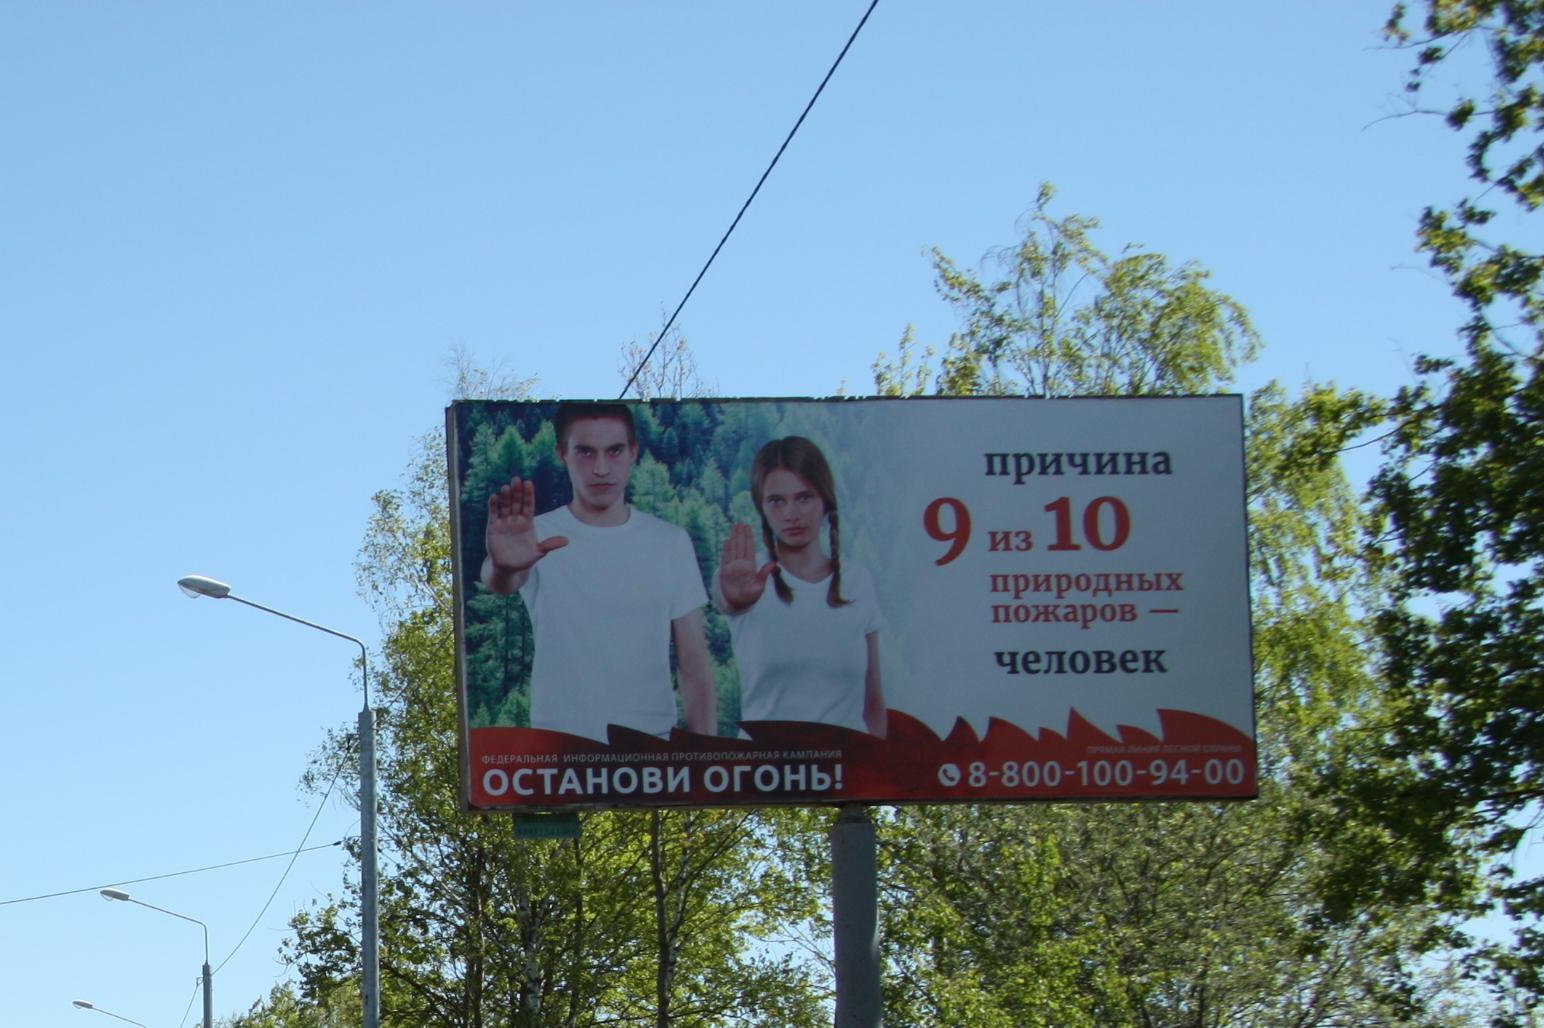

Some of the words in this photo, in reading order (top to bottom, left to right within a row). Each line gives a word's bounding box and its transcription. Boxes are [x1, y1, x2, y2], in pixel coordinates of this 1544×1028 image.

[983, 450, 1173, 485] причина
[923, 496, 972, 567] 9
[987, 530, 1034, 552] из
[1043, 495, 1131, 552] 10
[989, 572, 1185, 600] природных
[991, 602, 1139, 630] пожаров
[993, 648, 1169, 675] человек
[481, 753, 558, 765] ФЕДЕРАЛЬНАЯ
[563, 751, 669, 763] ИНФОРМАЦИОННАЯ
[671, 750, 780, 762] ПРОТИВОПОЖАРНАЯ
[782, 749, 843, 760] КАМПАНИЯ
[482, 765, 691, 797] ОСТАНОВИ
[703, 763, 844, 793] ОГОНЬ!
[967, 758, 1245, 787] 8-800-100-94-00
